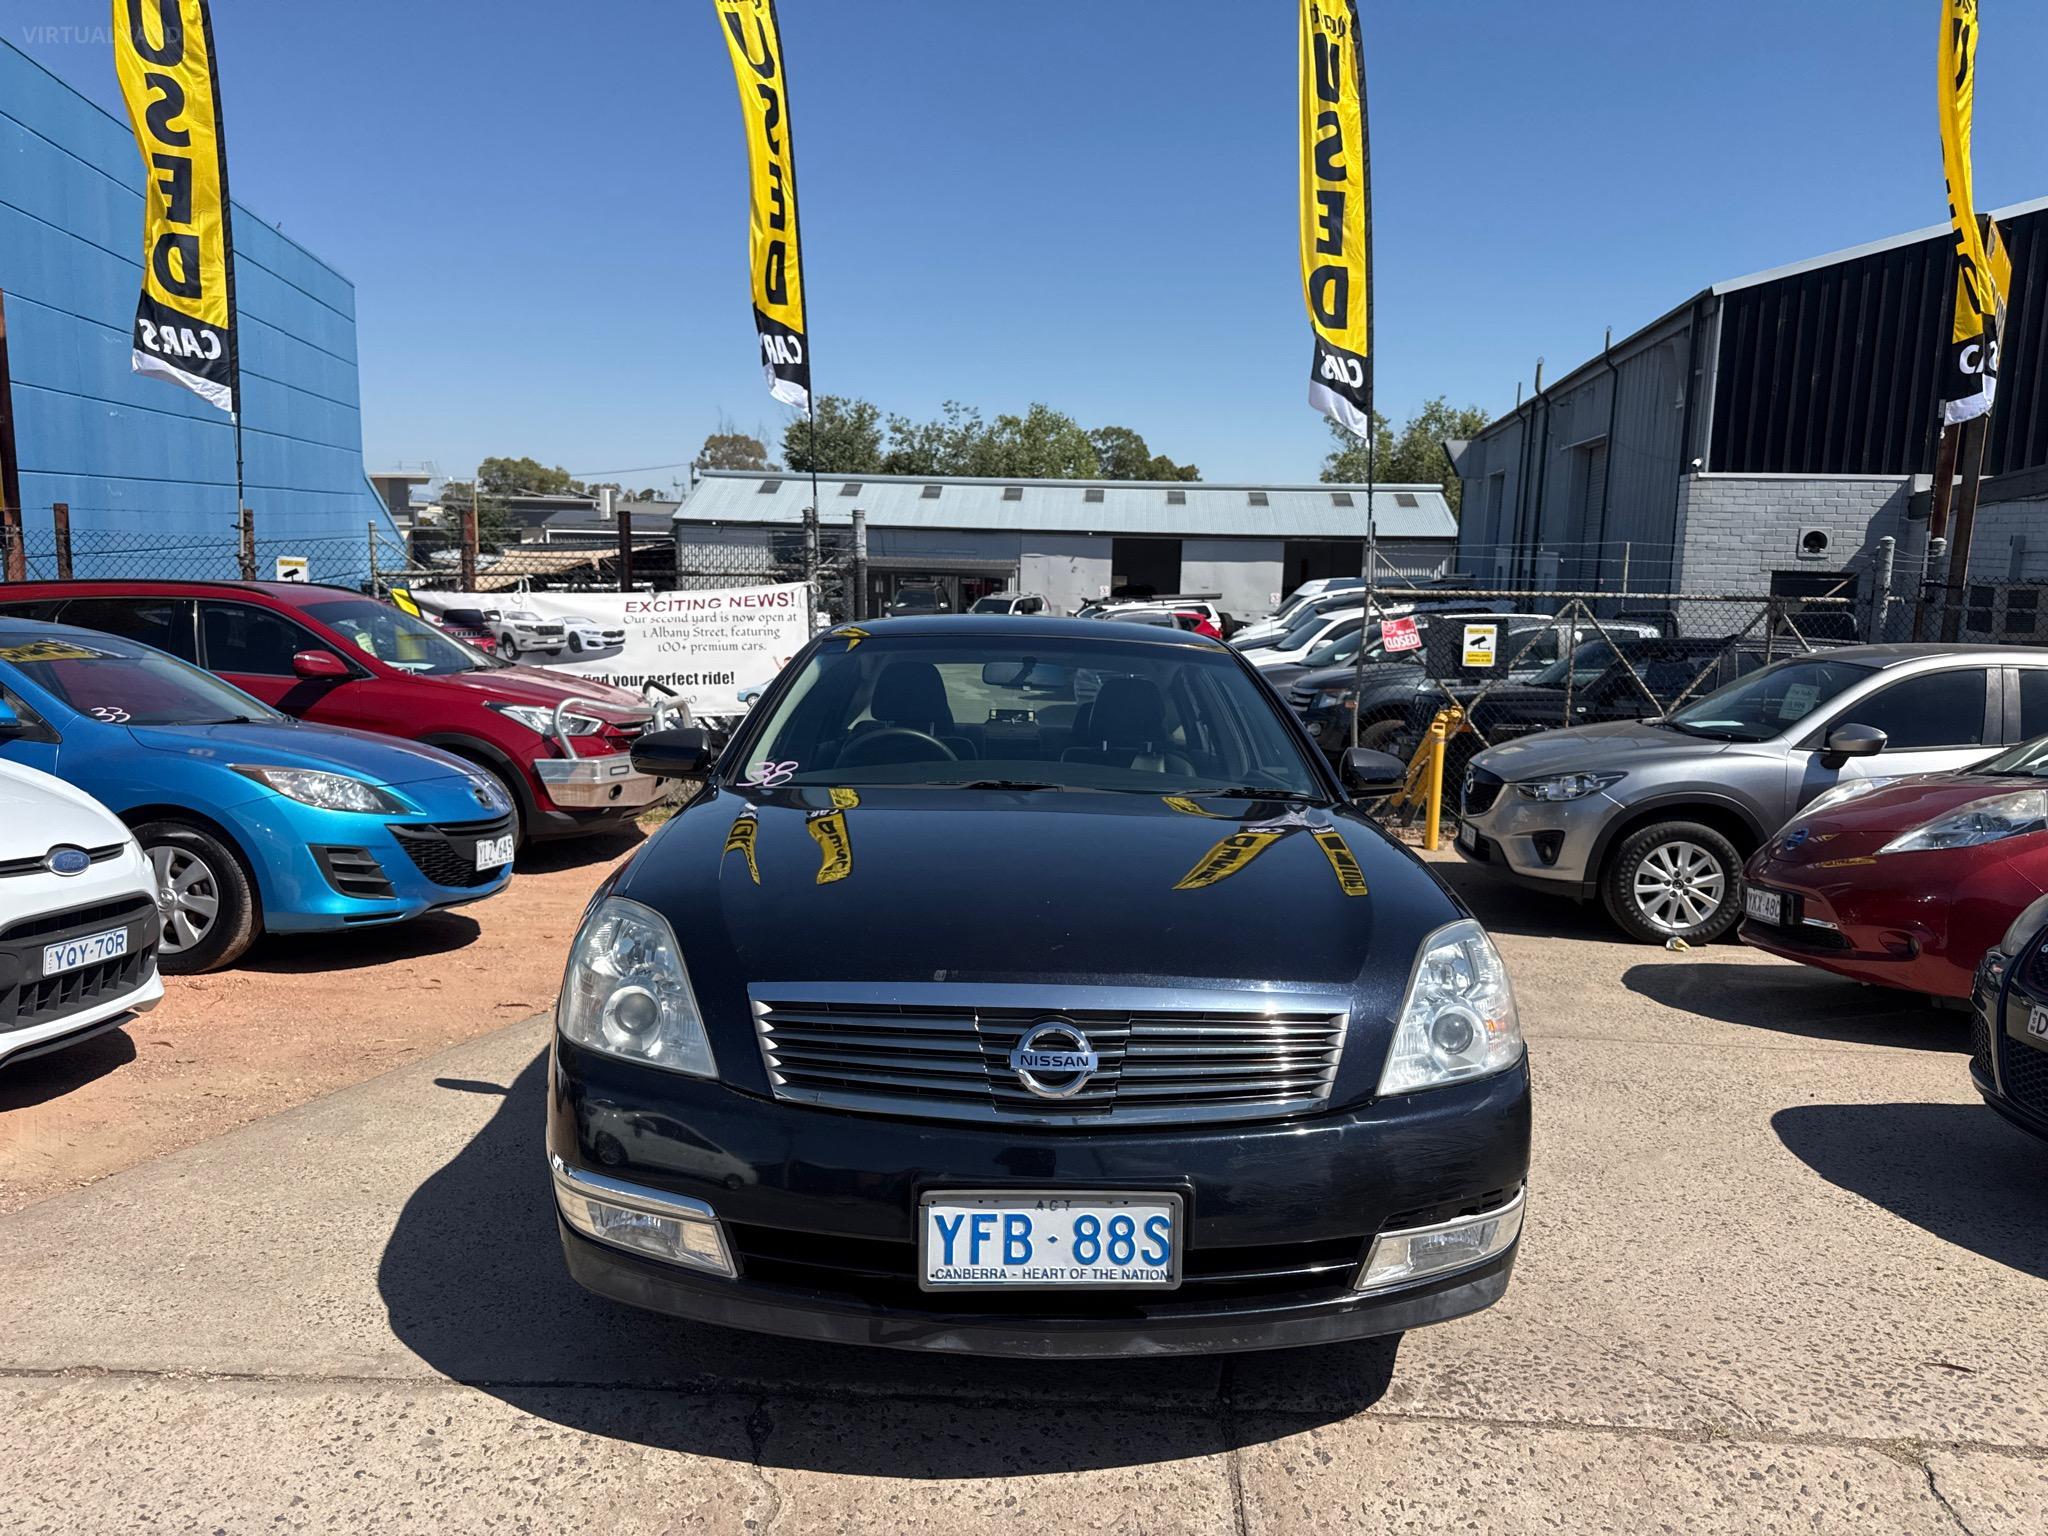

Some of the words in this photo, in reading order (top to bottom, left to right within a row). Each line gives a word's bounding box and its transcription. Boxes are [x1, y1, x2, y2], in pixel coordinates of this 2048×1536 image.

[625, 597, 722, 613] EXCITING
[729, 591, 795, 608] NEWS!
[623, 615, 647, 625] Our
[650, 612, 689, 623] second
[692, 612, 717, 626] yard
[720, 611, 730, 622] is
[732, 613, 755, 622] now
[758, 614, 784, 626] open
[786, 613, 797, 622] at
[650, 626, 690, 640] Albany
[693, 626, 728, 638] Street,
[731, 625, 781, 639] featuring
[691, 640, 739, 655] premium
[741, 642, 767, 651] cars.
[1385, 633, 1417, 649] CLOSED
[612, 675, 645, 687] your
[703, 671, 735, 685] ride!
[91, 706, 131, 723] 33
[736, 761, 799, 787] 38
[1020, 1055, 1089, 1067] NISSAN
[1035, 1199, 1071, 1211] ACT
[935, 1268, 1007, 1280] CANBERRA
[1022, 1268, 1066, 1280] HEART
[1069, 1268, 1088, 1280] OF
[1092, 1268, 1118, 1280] THE
[1121, 1268, 1170, 1280] NATION
